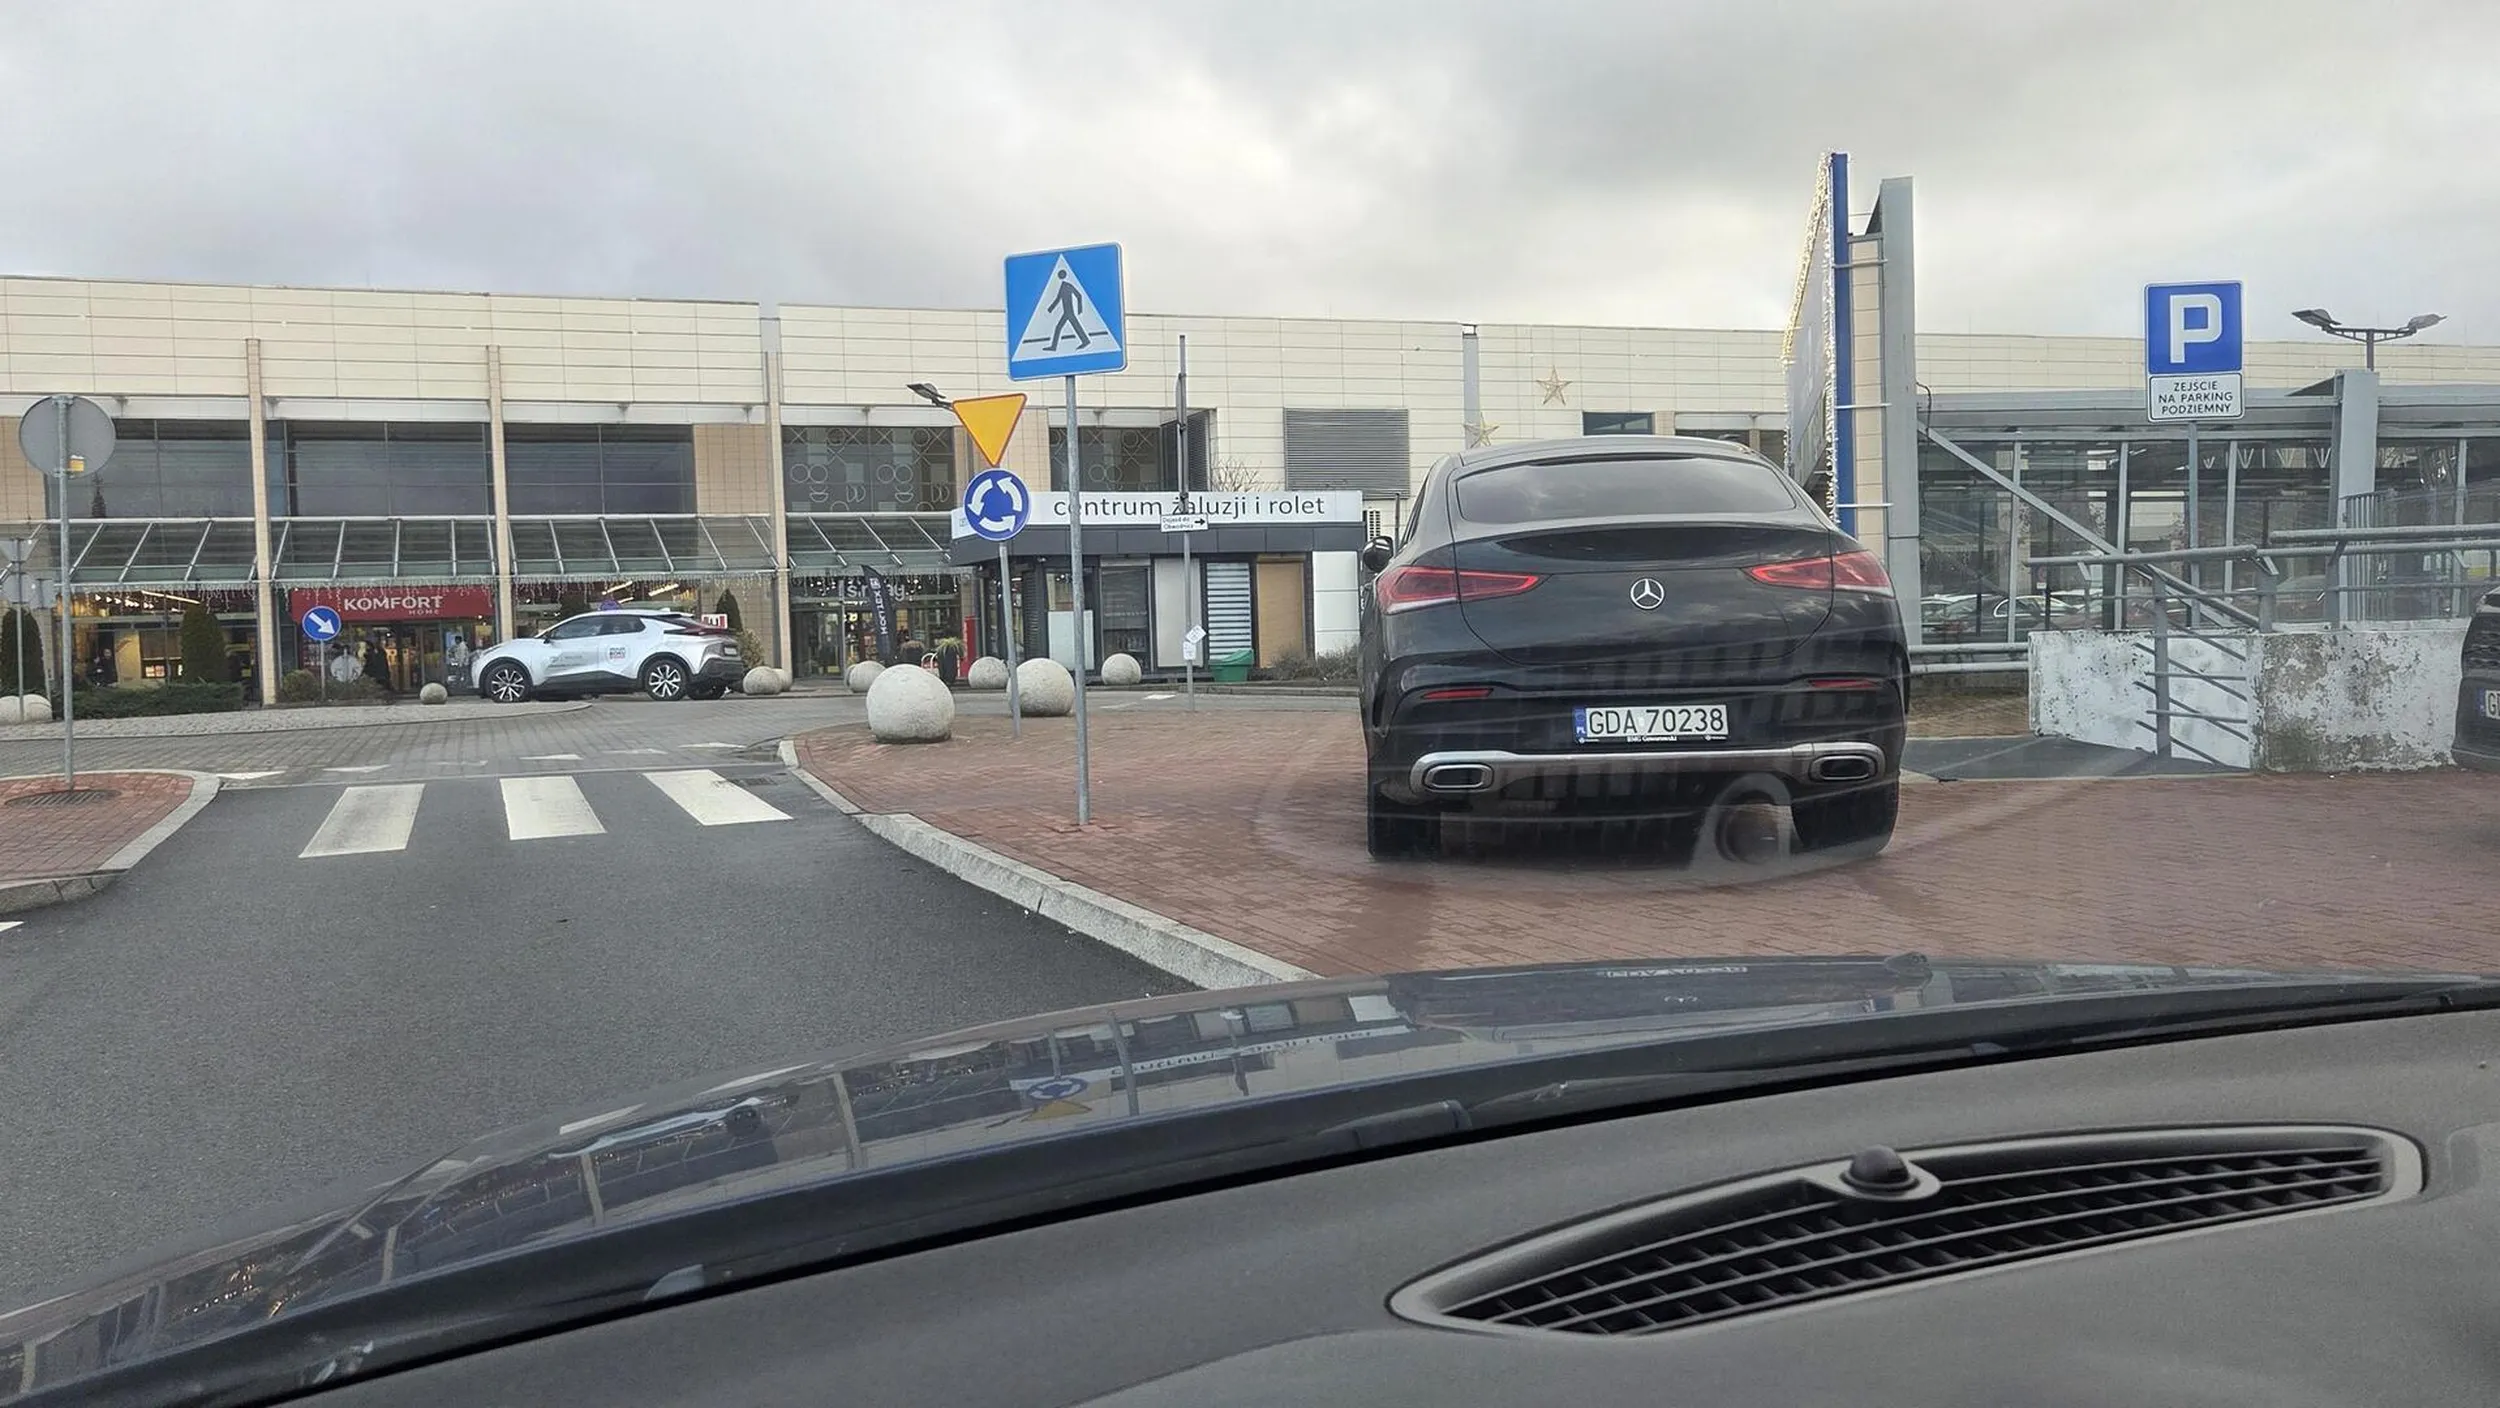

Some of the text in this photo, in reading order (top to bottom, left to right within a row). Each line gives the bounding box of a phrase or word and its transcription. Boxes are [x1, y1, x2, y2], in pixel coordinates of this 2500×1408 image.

[2169, 293, 2222, 363] P
[2174, 380, 2218, 391] ZEJŚCIE
[2159, 391, 2233, 404] NA PARKING
[2161, 403, 2232, 415] PODZIEMNY
[1255, 496, 1260, 514] i
[1269, 495, 1325, 515] rolet
[343, 595, 443, 611] KOMFORT
[1589, 708, 1724, 734] GDA 70238
[1576, 726, 1586, 734] PL
